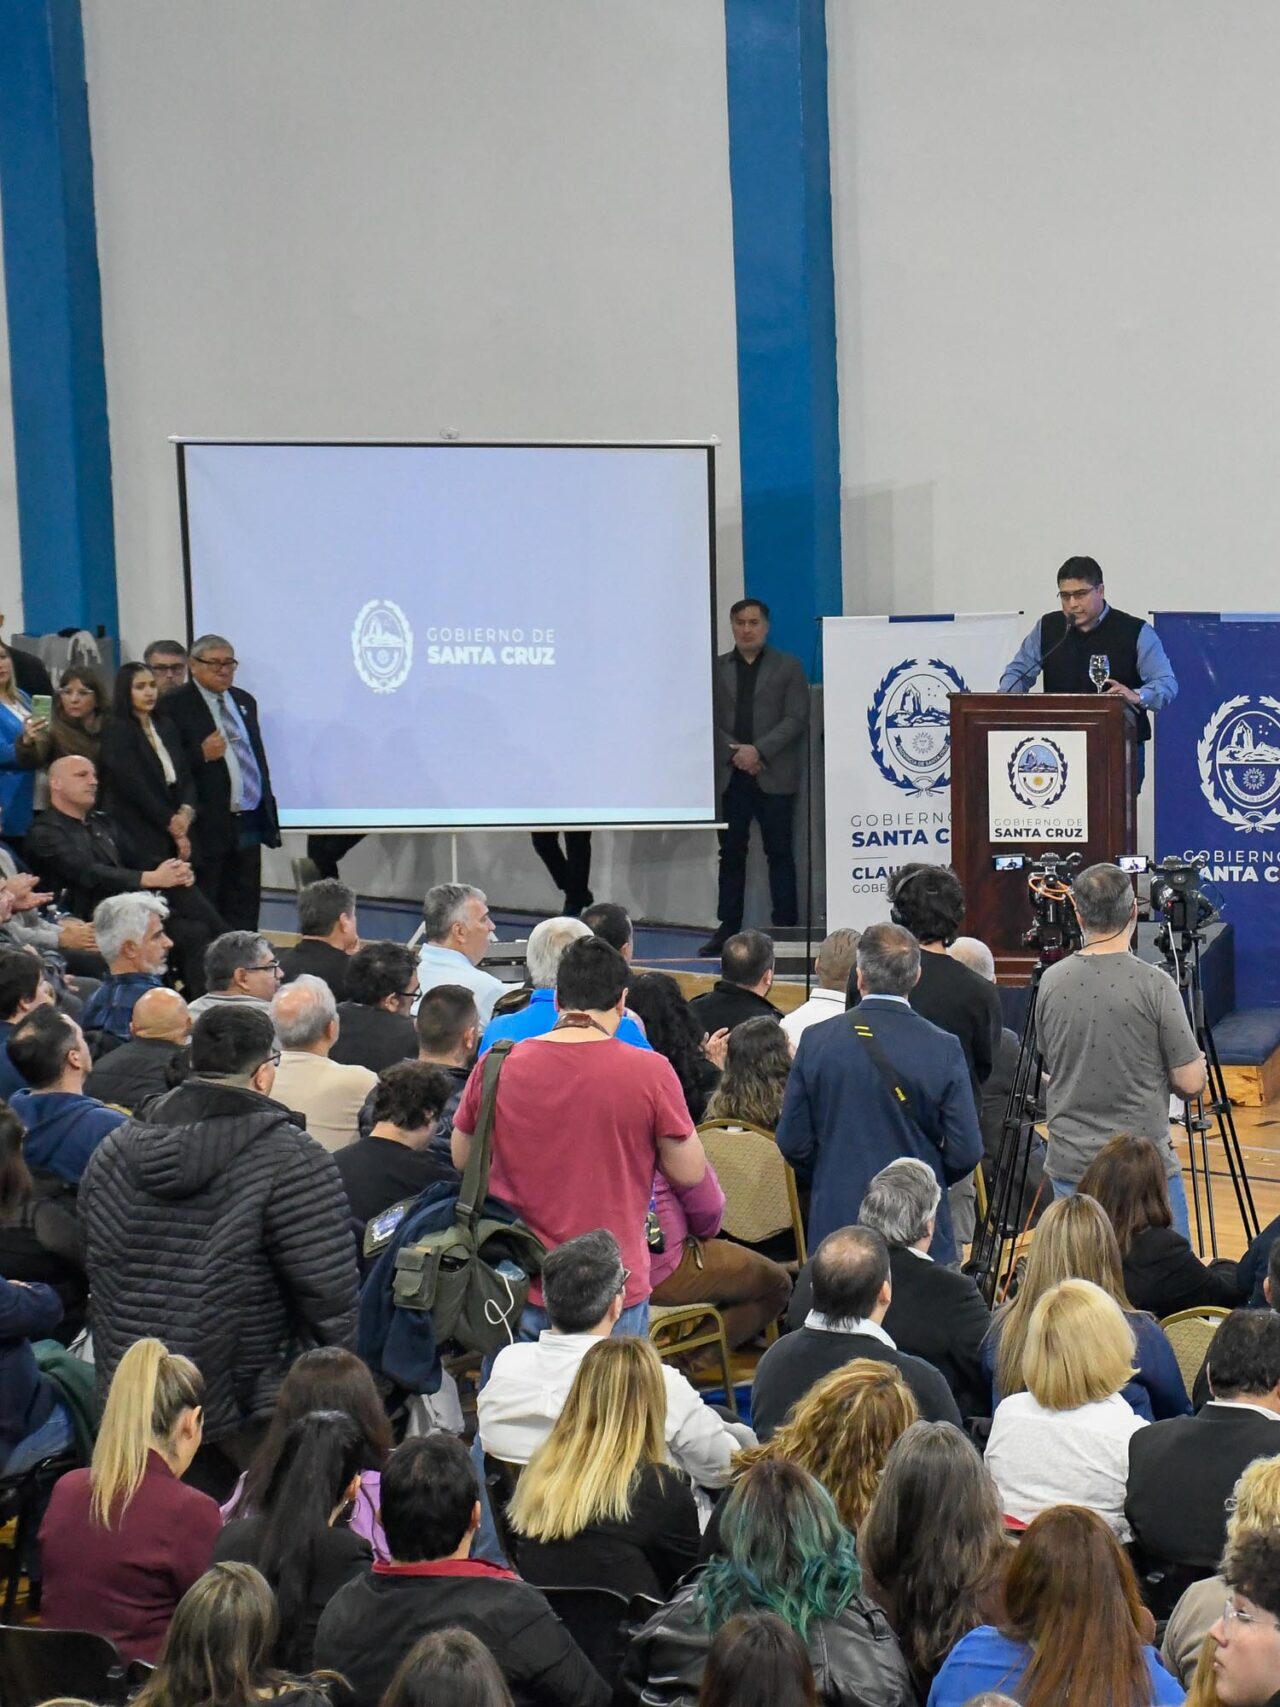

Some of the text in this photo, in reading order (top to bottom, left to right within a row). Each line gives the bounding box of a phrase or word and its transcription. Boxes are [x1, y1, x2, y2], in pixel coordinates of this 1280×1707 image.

[426, 627, 555, 643] GOBIERNO DE
[427, 646, 556, 665] SANTA CRUZ
[994, 818, 1083, 827] GOBIERNO DE
[852, 829, 929, 848] SANTA
[994, 828, 1083, 838] SANTA CRUZ
[1199, 866, 1259, 882] ANTA
